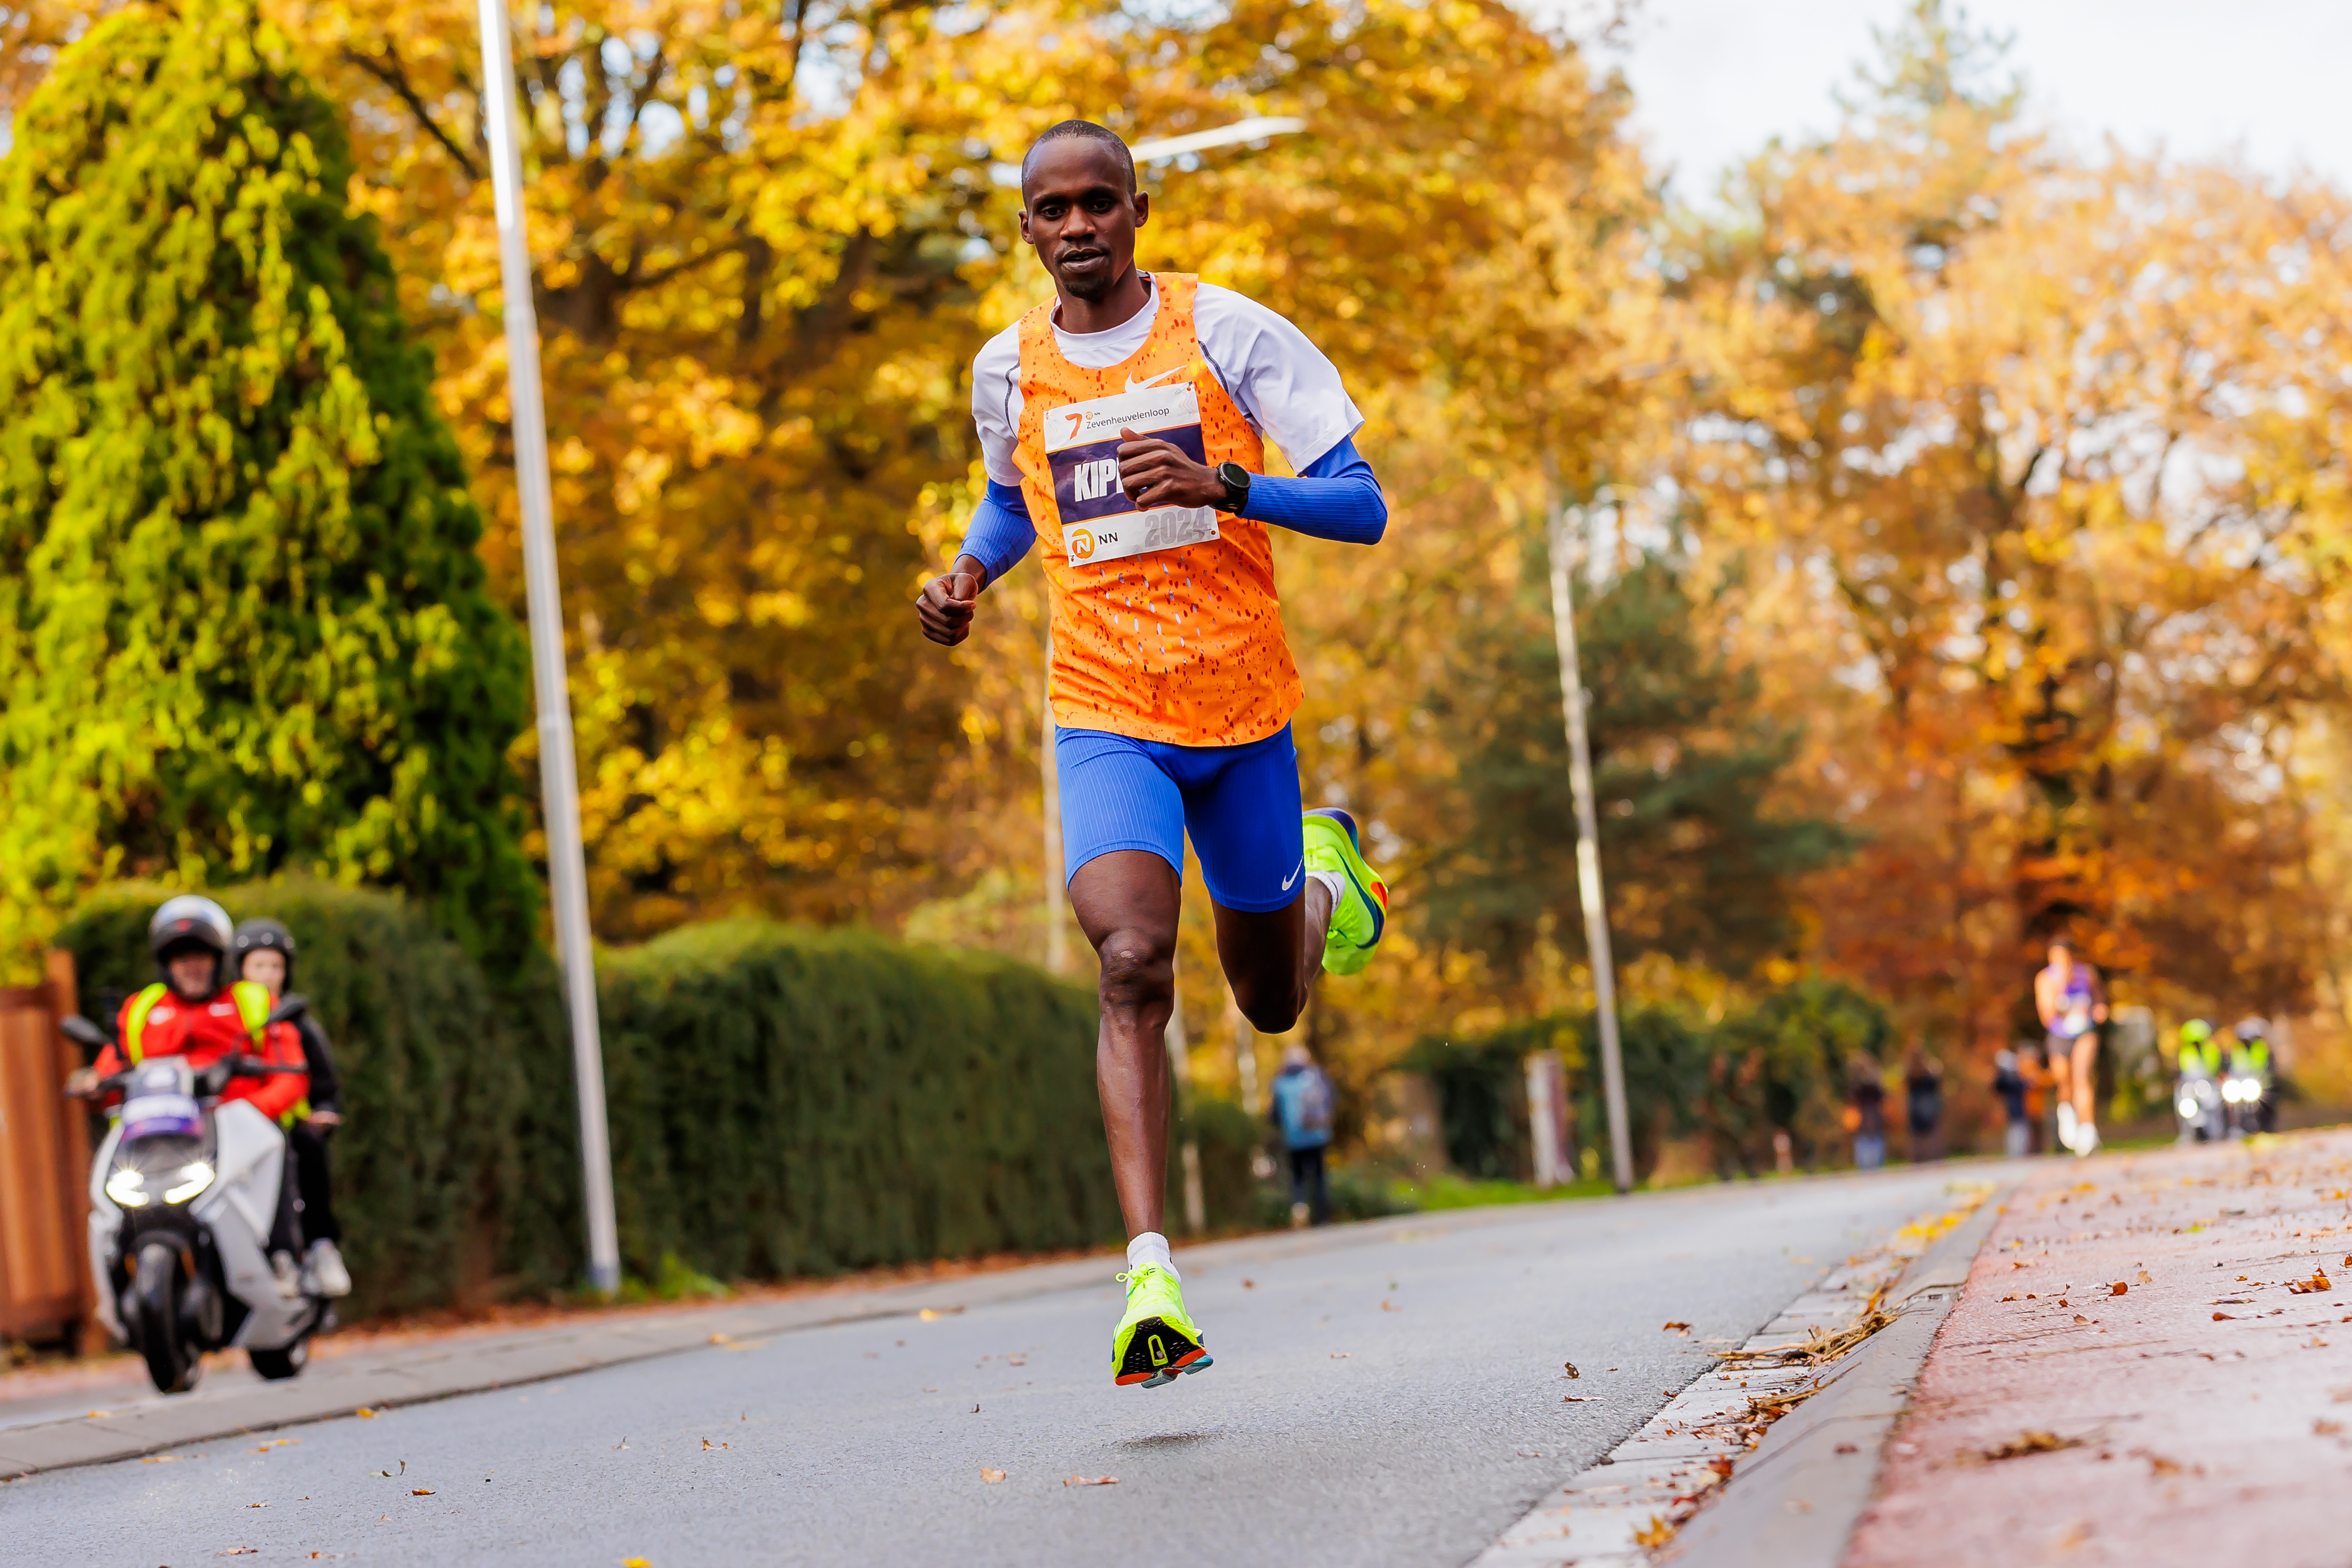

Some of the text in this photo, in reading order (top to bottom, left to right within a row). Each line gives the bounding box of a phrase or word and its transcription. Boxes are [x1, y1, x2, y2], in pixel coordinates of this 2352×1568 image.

[1065, 413, 1082, 440] 7
[1086, 408, 1169, 429] Zevenheuvelenloop
[1098, 532, 1118, 545] NN
[1145, 507, 1207, 548] 2024
